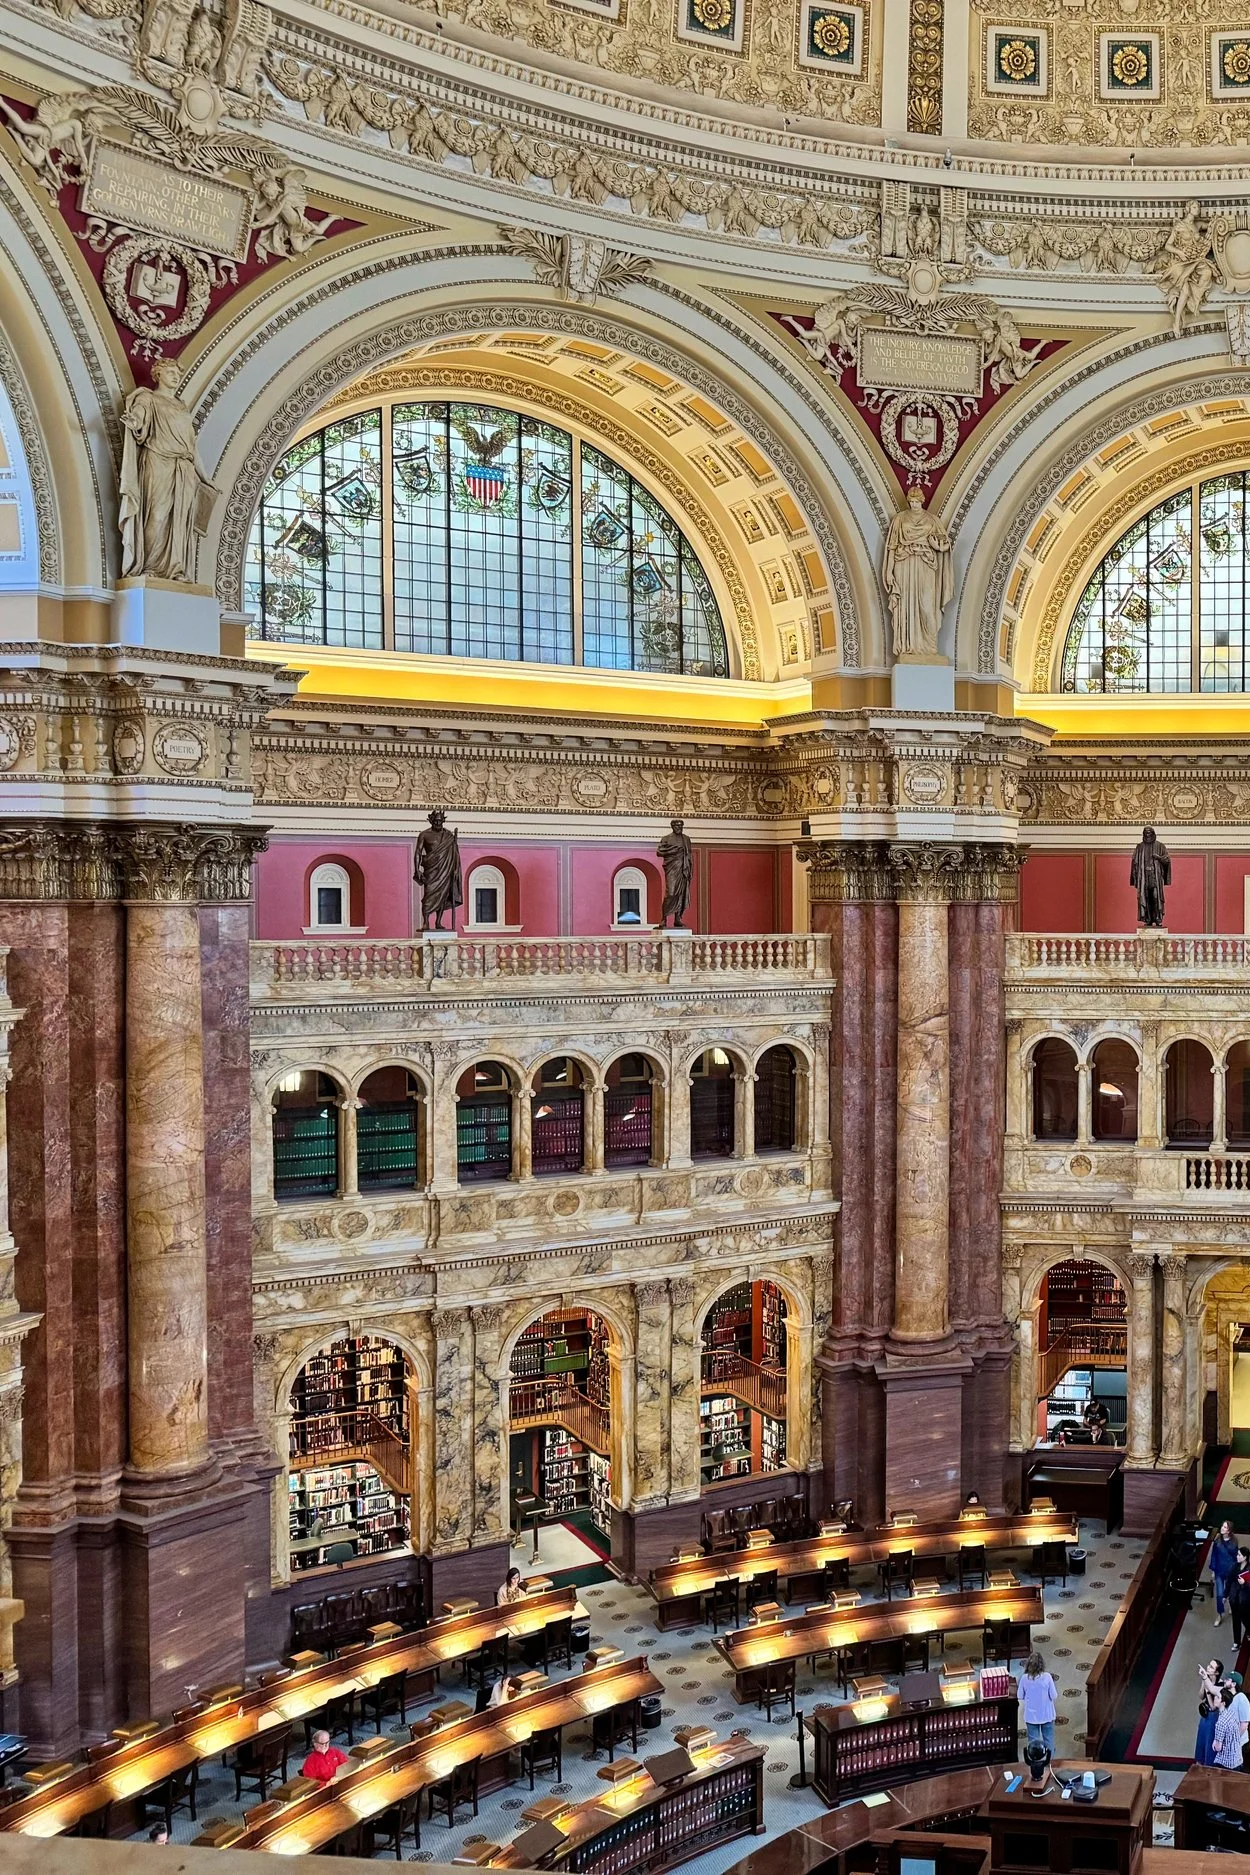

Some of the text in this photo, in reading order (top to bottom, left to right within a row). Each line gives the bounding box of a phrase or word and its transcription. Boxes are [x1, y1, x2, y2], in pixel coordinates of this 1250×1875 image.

[159, 173, 175, 186] AS
[178, 179, 192, 191] TO
[192, 182, 224, 203] THEIR
[93, 188, 137, 213] GOLDEN
[140, 204, 168, 222] VRNS
[170, 214, 202, 233] DRAW
[161, 187, 199, 207] OTHER
[204, 202, 236, 220] STARS
[173, 202, 185, 215] IN
[188, 206, 220, 227] THEIR
[870, 336, 885, 347] THE
[871, 356, 969, 375] IS THE SOVEREIGN GOOD
[874, 347, 966, 365] AND BELIEF OF TRVTH
[169, 744, 195, 754] POETRY
